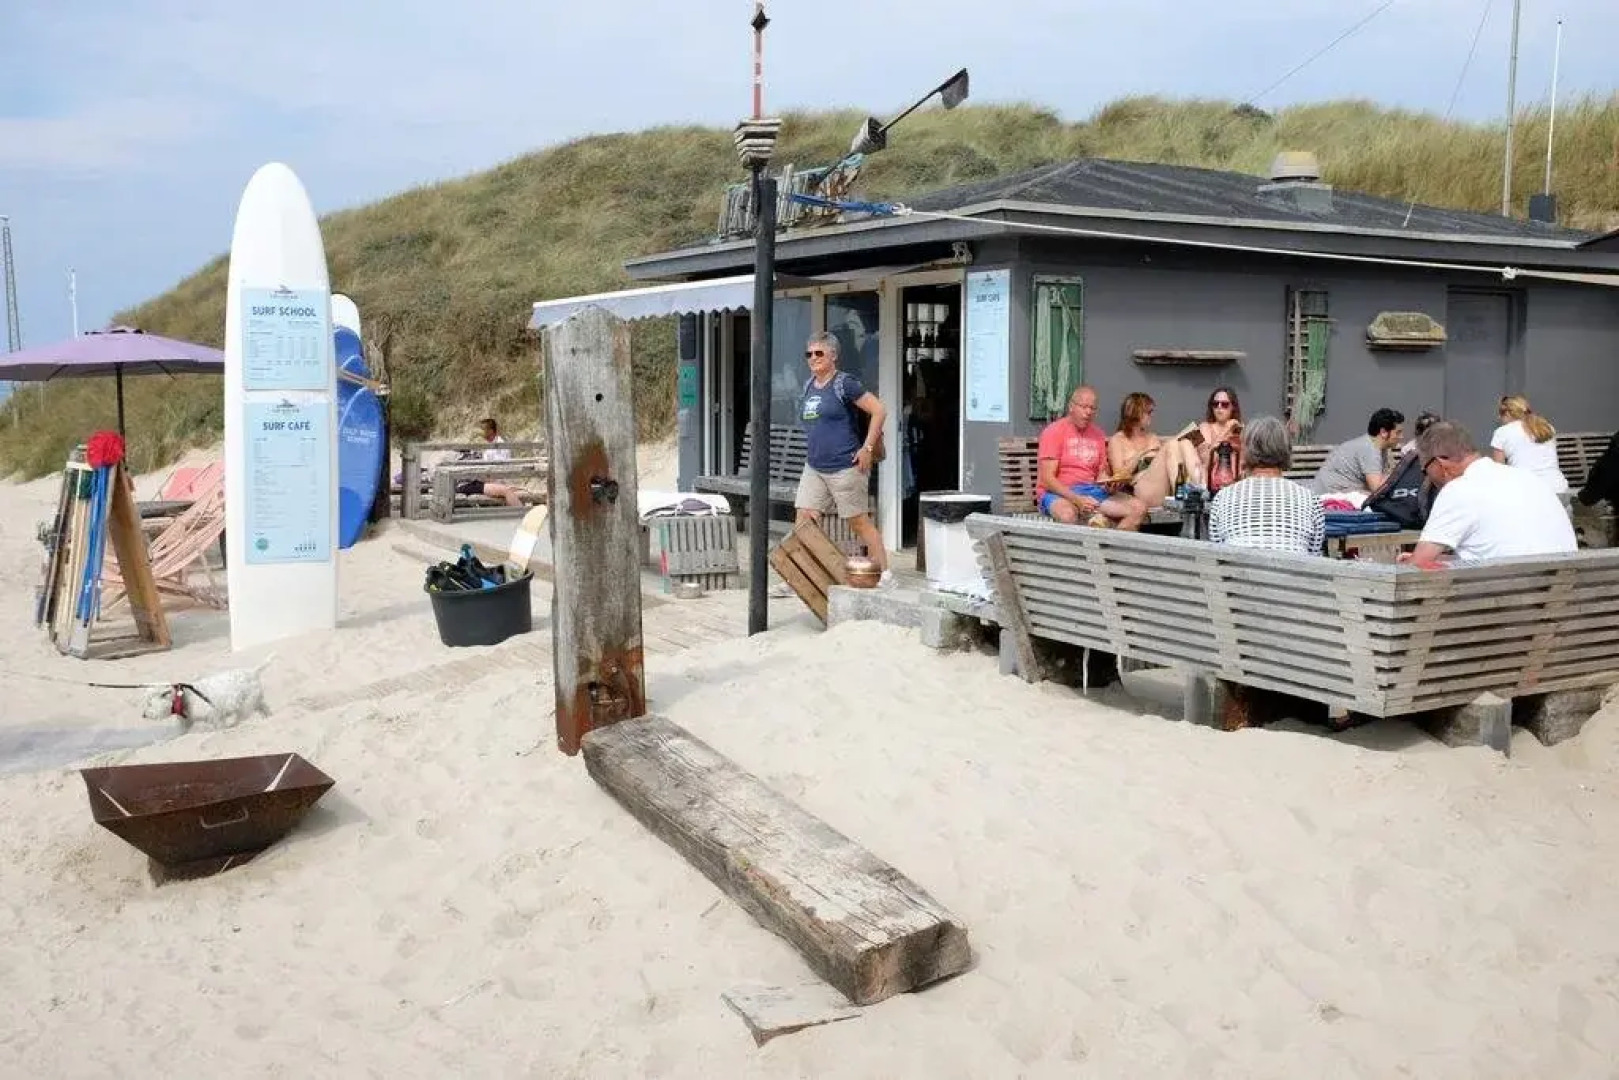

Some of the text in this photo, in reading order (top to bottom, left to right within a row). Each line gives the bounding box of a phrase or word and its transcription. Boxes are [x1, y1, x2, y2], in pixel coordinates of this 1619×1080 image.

[252, 306, 317, 317] SURF SCHOOL
[262, 418, 311, 431] SURF CAFÉ
